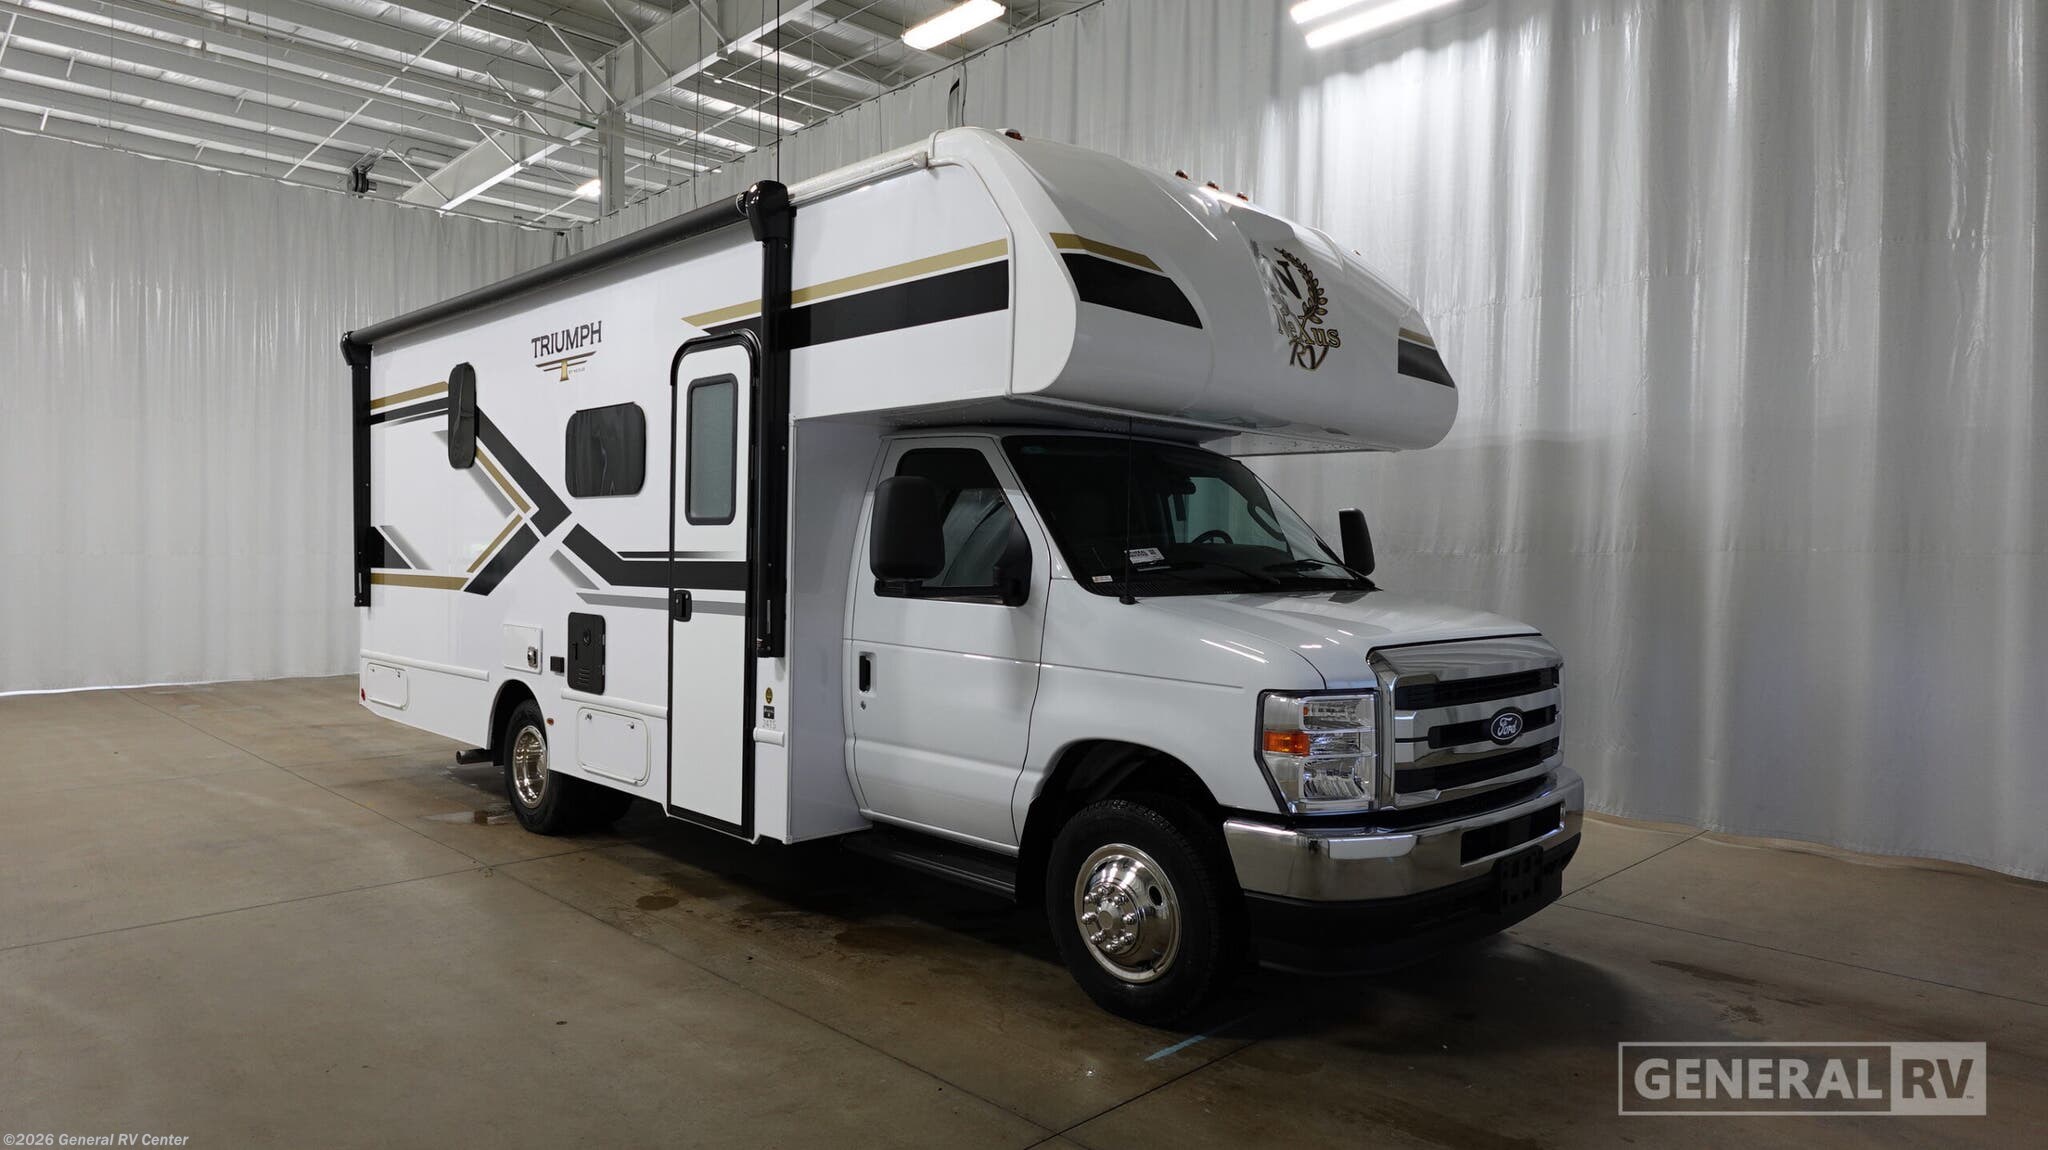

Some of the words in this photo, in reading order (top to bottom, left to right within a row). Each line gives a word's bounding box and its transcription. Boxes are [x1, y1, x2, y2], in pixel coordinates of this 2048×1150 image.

[531, 320, 602, 358] TRIUMPH
[1288, 340, 1329, 370] RV
[1497, 717, 1517, 736] Ford
